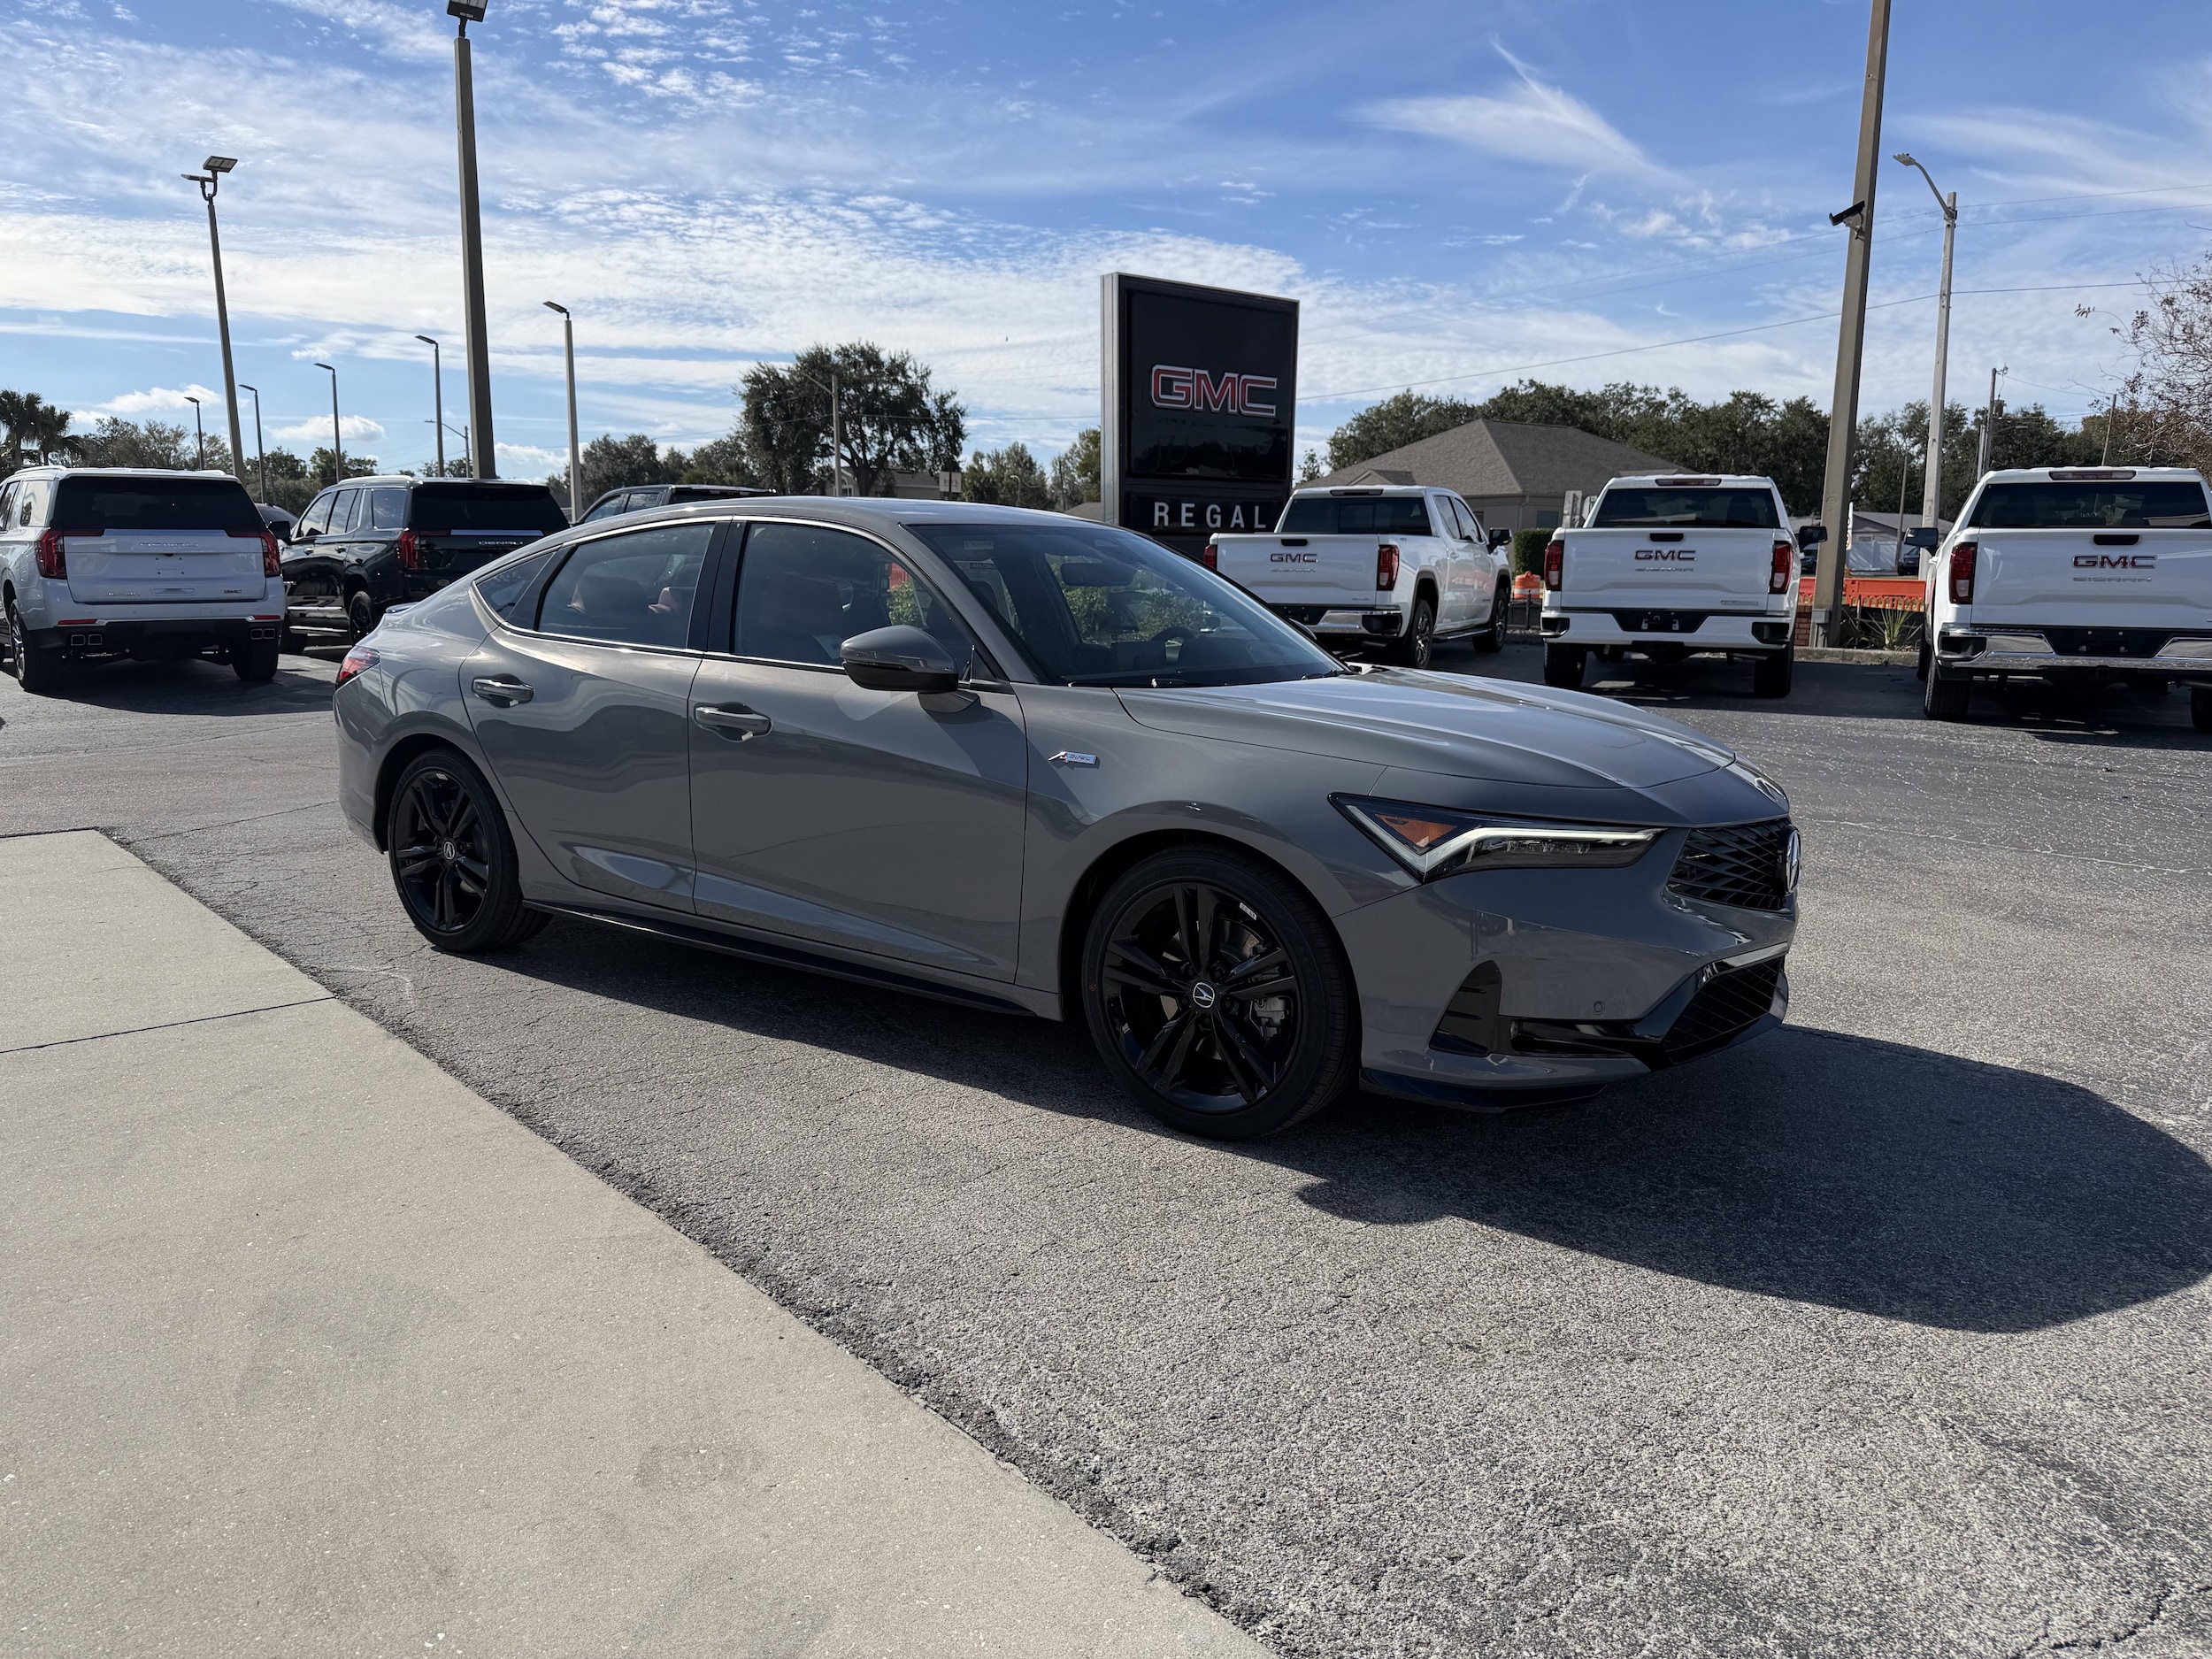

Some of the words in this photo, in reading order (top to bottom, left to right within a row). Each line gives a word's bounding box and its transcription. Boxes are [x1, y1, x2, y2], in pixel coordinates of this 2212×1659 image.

[1152, 365, 1278, 418] GMC
[1154, 502, 1266, 528] REGAL
[1271, 553, 1317, 563] GMC
[1634, 549, 1696, 561] GMC
[2073, 555, 2157, 569] GMC
